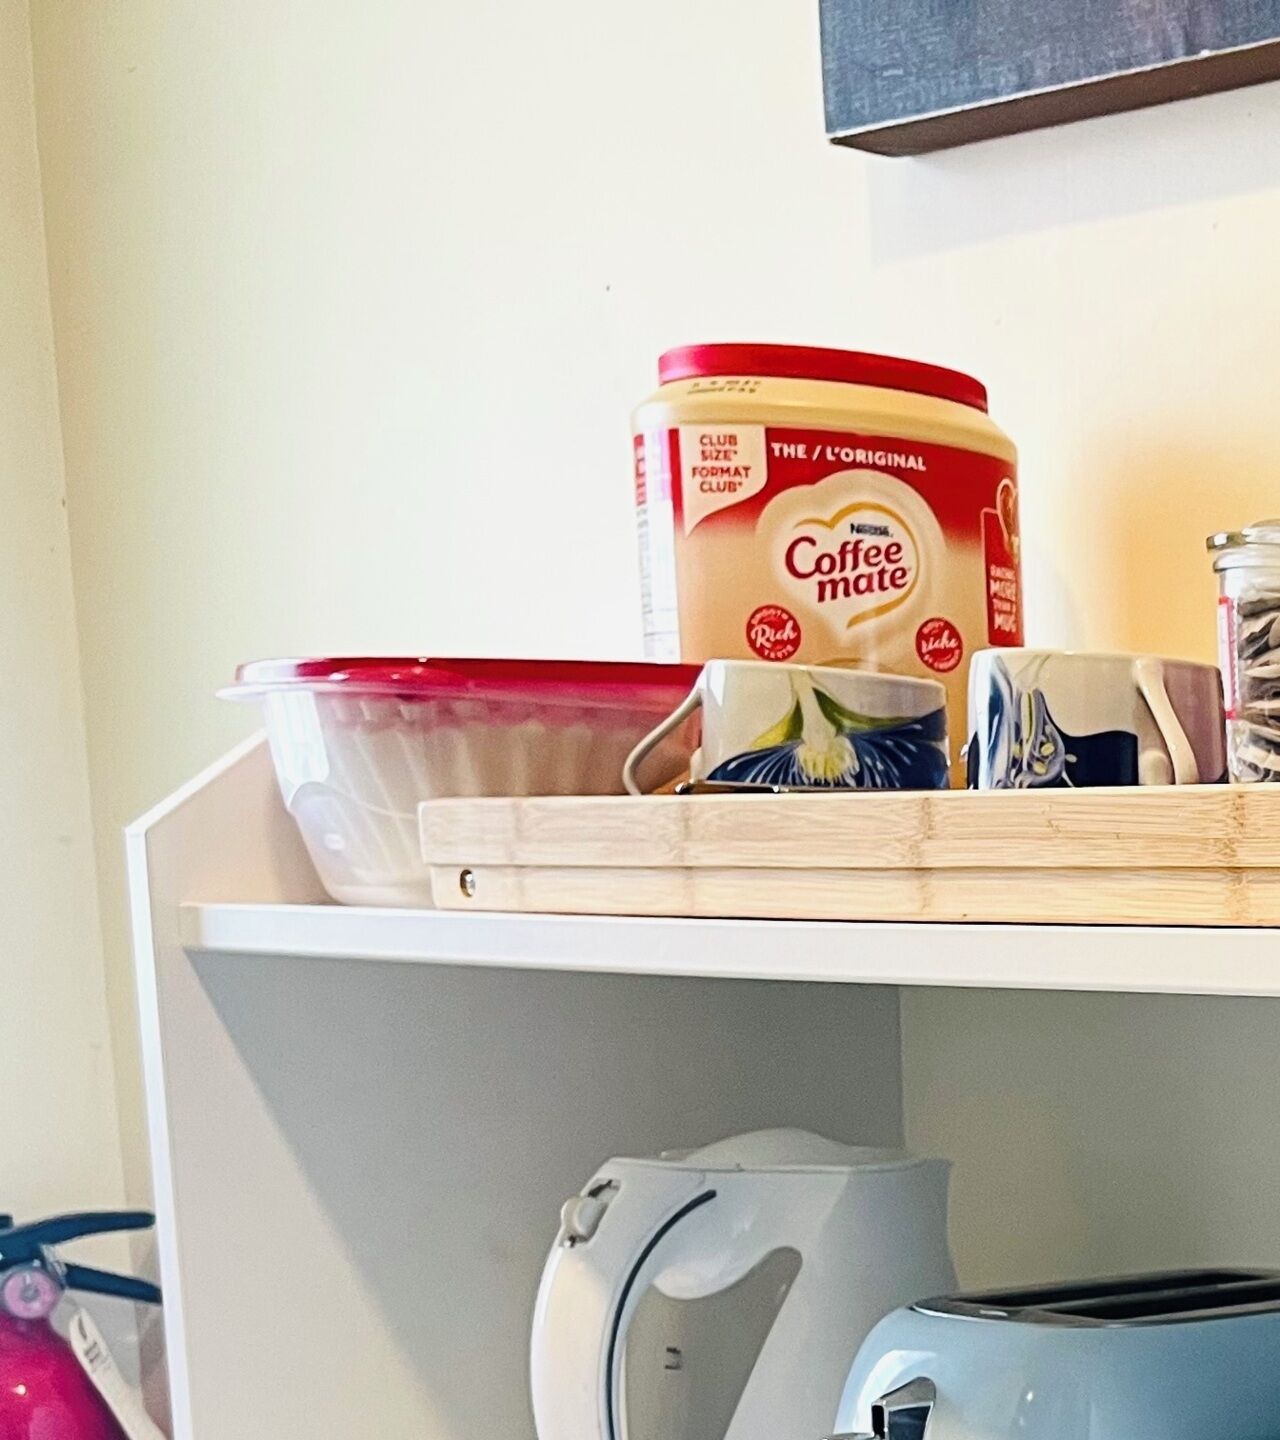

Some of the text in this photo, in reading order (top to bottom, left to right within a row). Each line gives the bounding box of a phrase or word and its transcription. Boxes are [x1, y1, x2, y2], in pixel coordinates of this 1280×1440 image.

[700, 434, 738, 447] CLUB
[771, 442, 927, 472] THE / L'ORIGINAL
[692, 466, 752, 479] FORMAT
[785, 536, 903, 579] Coffee
[818, 566, 909, 603] mate
[750, 620, 798, 649] Rich
